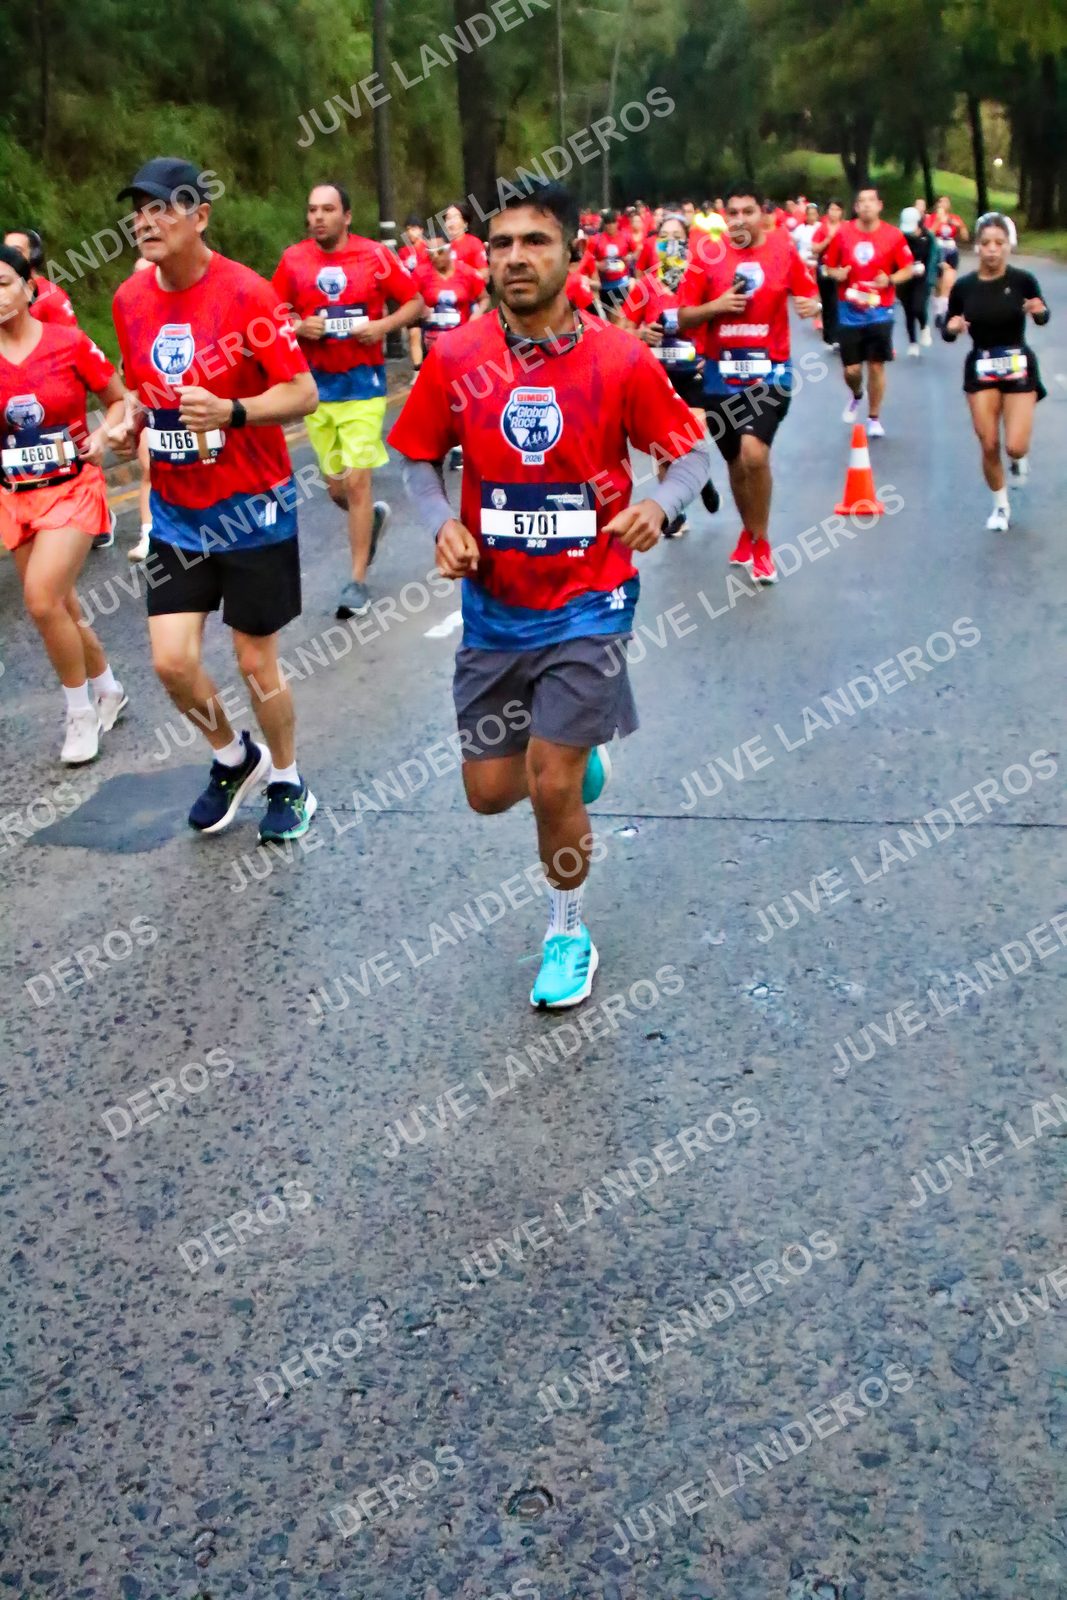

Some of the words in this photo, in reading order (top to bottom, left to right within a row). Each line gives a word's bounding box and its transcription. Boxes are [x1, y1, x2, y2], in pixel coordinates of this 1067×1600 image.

[516, 406, 548, 418] Global
[510, 418, 537, 428] Race
[160, 431, 194, 449] 4766
[22, 446, 53, 462] 4680
[514, 514, 558, 535] 5701
